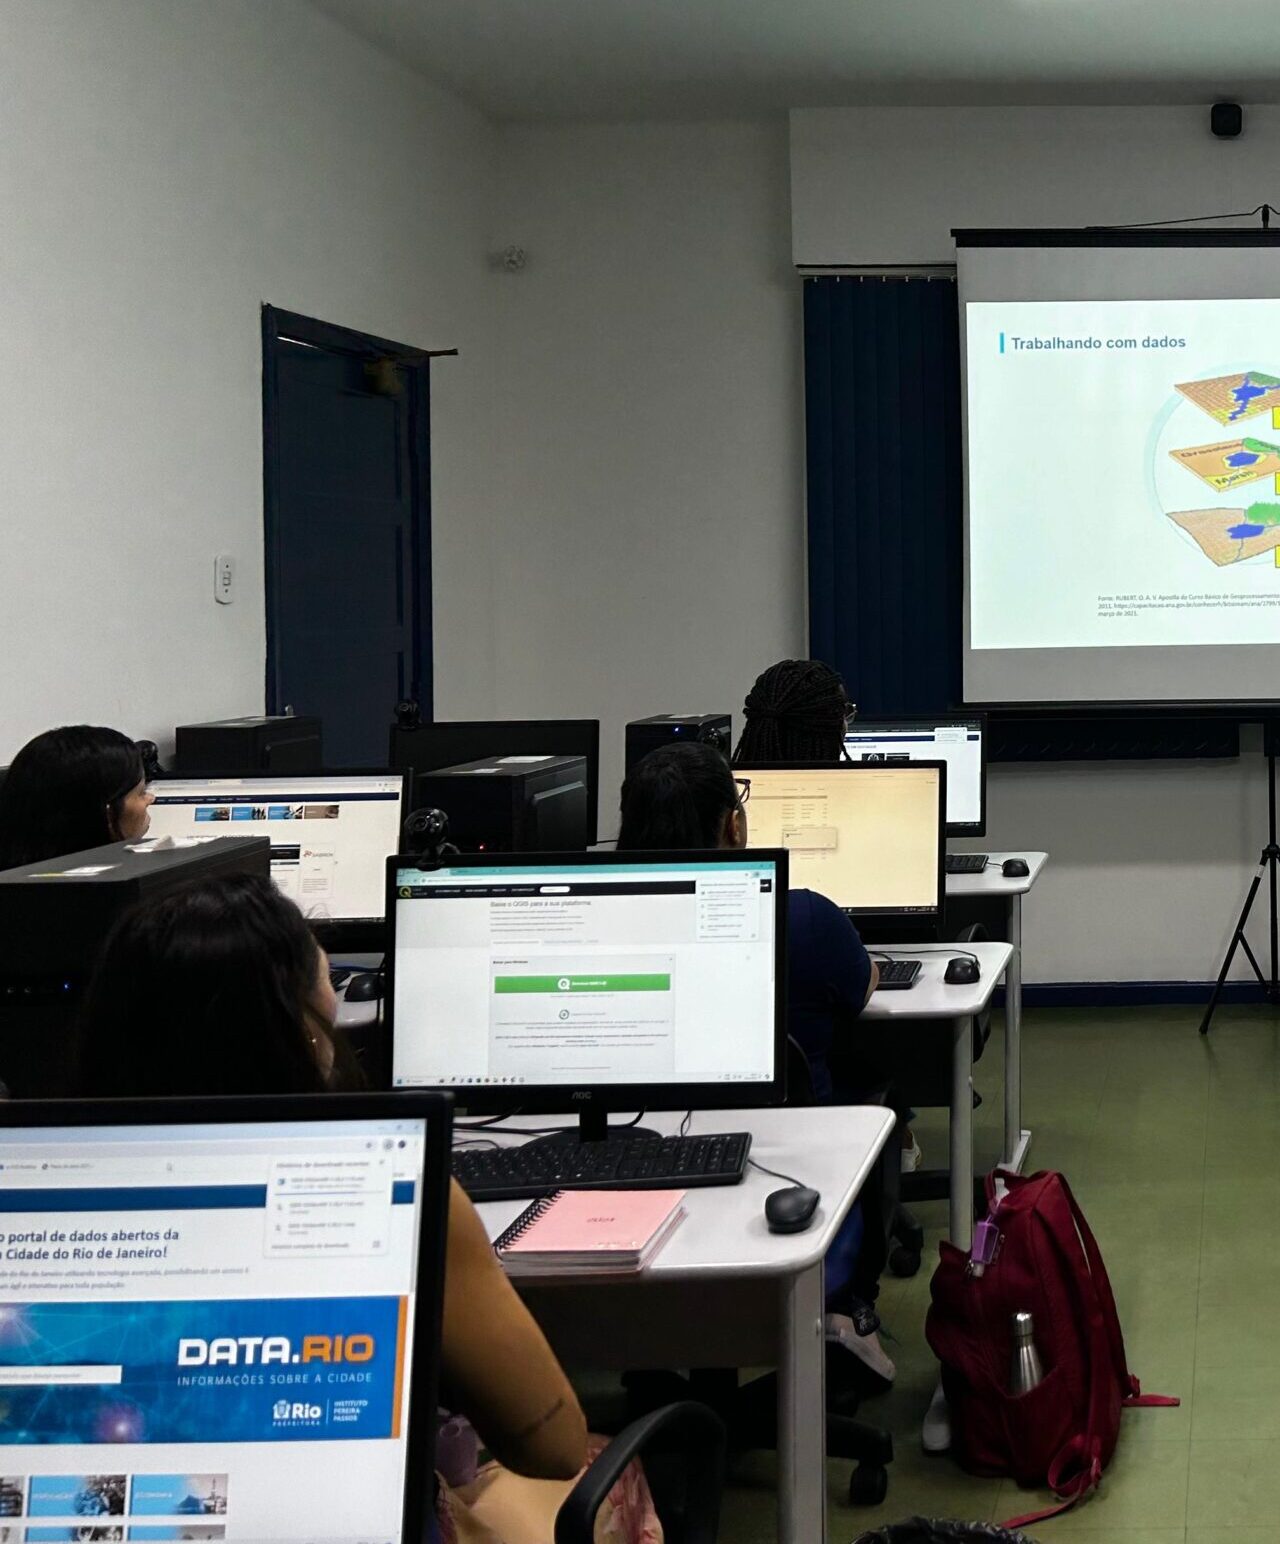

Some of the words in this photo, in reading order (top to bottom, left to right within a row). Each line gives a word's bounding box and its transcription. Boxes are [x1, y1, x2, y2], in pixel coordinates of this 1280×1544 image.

[1011, 337, 1102, 350] Trabalhando
[1106, 338, 1137, 349] com
[1141, 336, 1186, 348] dados
[530, 901, 543, 909] para
[561, 900, 591, 908] plataforma
[571, 1091, 592, 1099] AOC
[8, 1230, 47, 1245] portal
[49, 1230, 66, 1242] de
[69, 1229, 108, 1242] dados
[111, 1229, 160, 1241] abertos
[163, 1228, 179, 1240] da
[6, 1248, 49, 1260] Cidade
[52, 1248, 69, 1260] do
[72, 1248, 93, 1259] Rio
[96, 1247, 112, 1259] de
[115, 1246, 168, 1259] Janeiro!
[177, 1334, 374, 1366] DATA.RIO
[177, 1373, 265, 1387] INFORMAÇÕES
[269, 1373, 309, 1384] SOBRE
[314, 1373, 321, 1383] A
[327, 1372, 372, 1384] CIDADE
[292, 1402, 321, 1419] Rio
